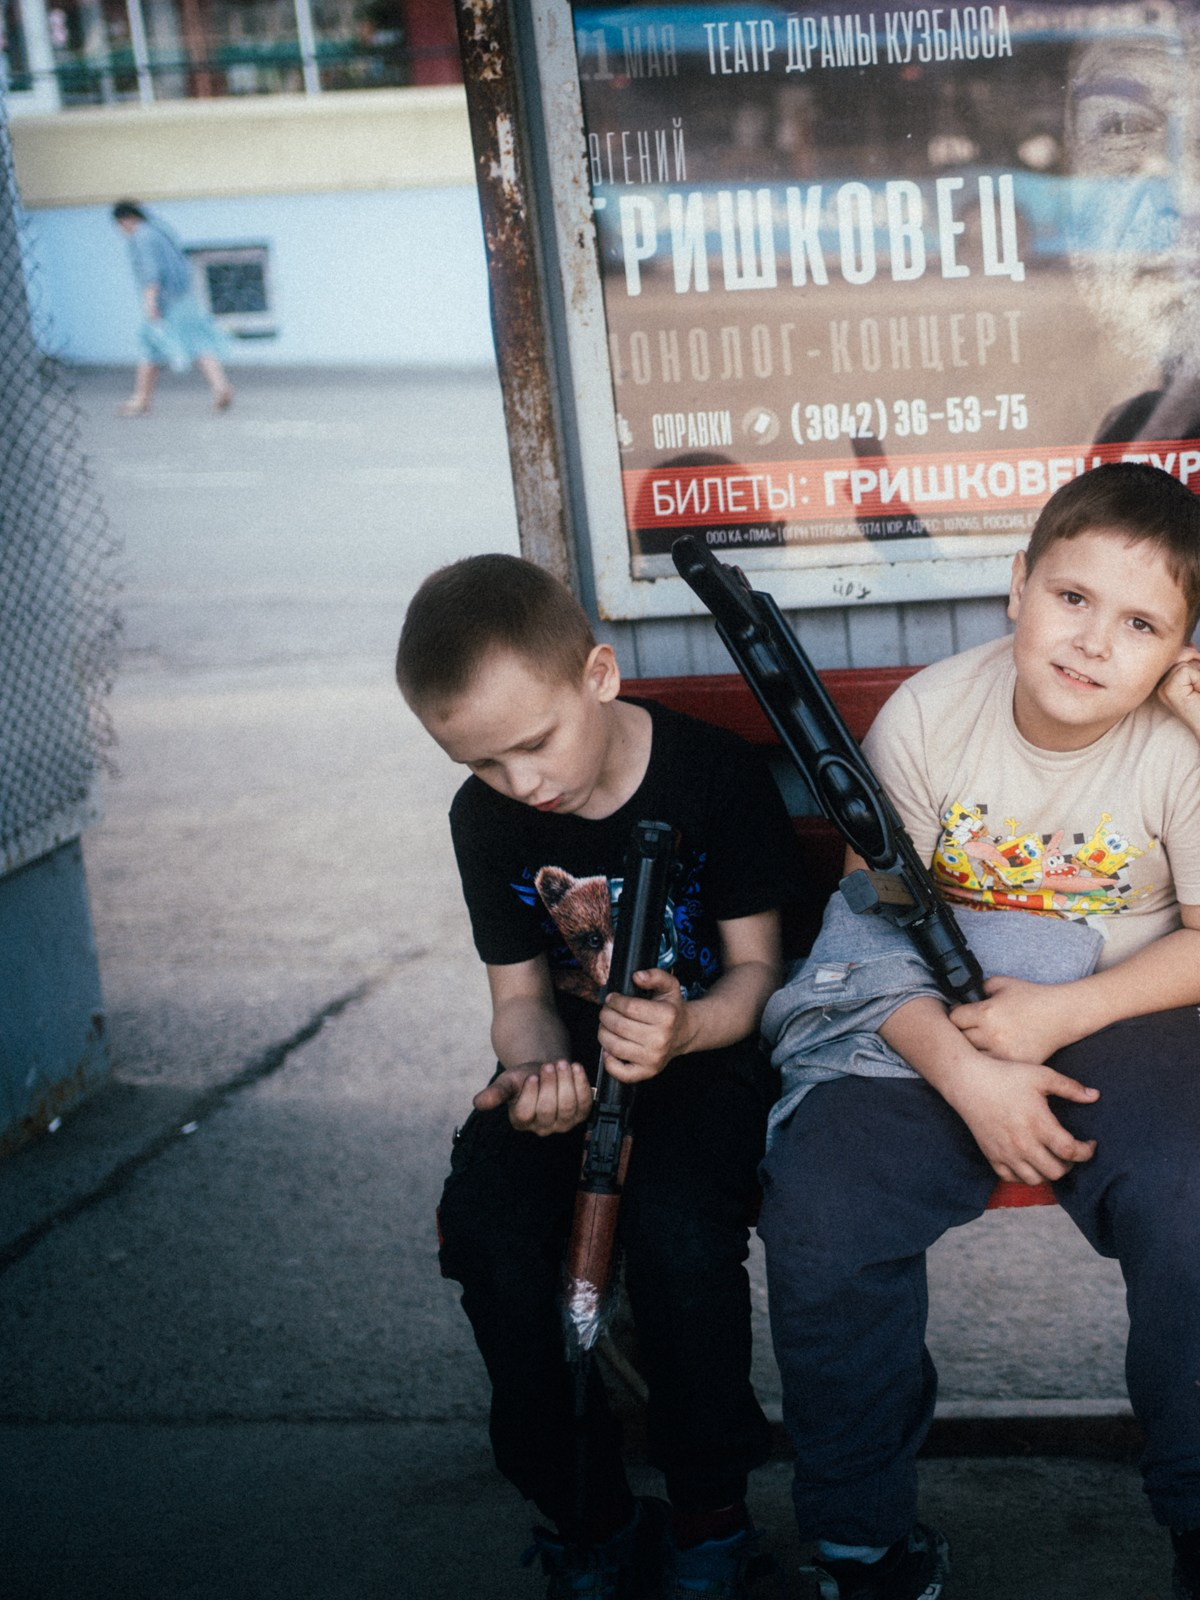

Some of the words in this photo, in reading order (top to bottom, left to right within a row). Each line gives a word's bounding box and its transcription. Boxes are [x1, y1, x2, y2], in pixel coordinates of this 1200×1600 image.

[622, 24, 678, 79] МАЯ
[703, 20, 775, 75] ТЕАТР
[785, 13, 878, 73] ДРАМЫ
[885, 5, 1012, 64] КУЗБАССА
[652, 409, 732, 449] СПРАВКИ
[791, 398, 888, 445] (3842)
[894, 394, 1029, 437] 36-53-75
[652, 473, 810, 516] БИЛЕТЫ:
